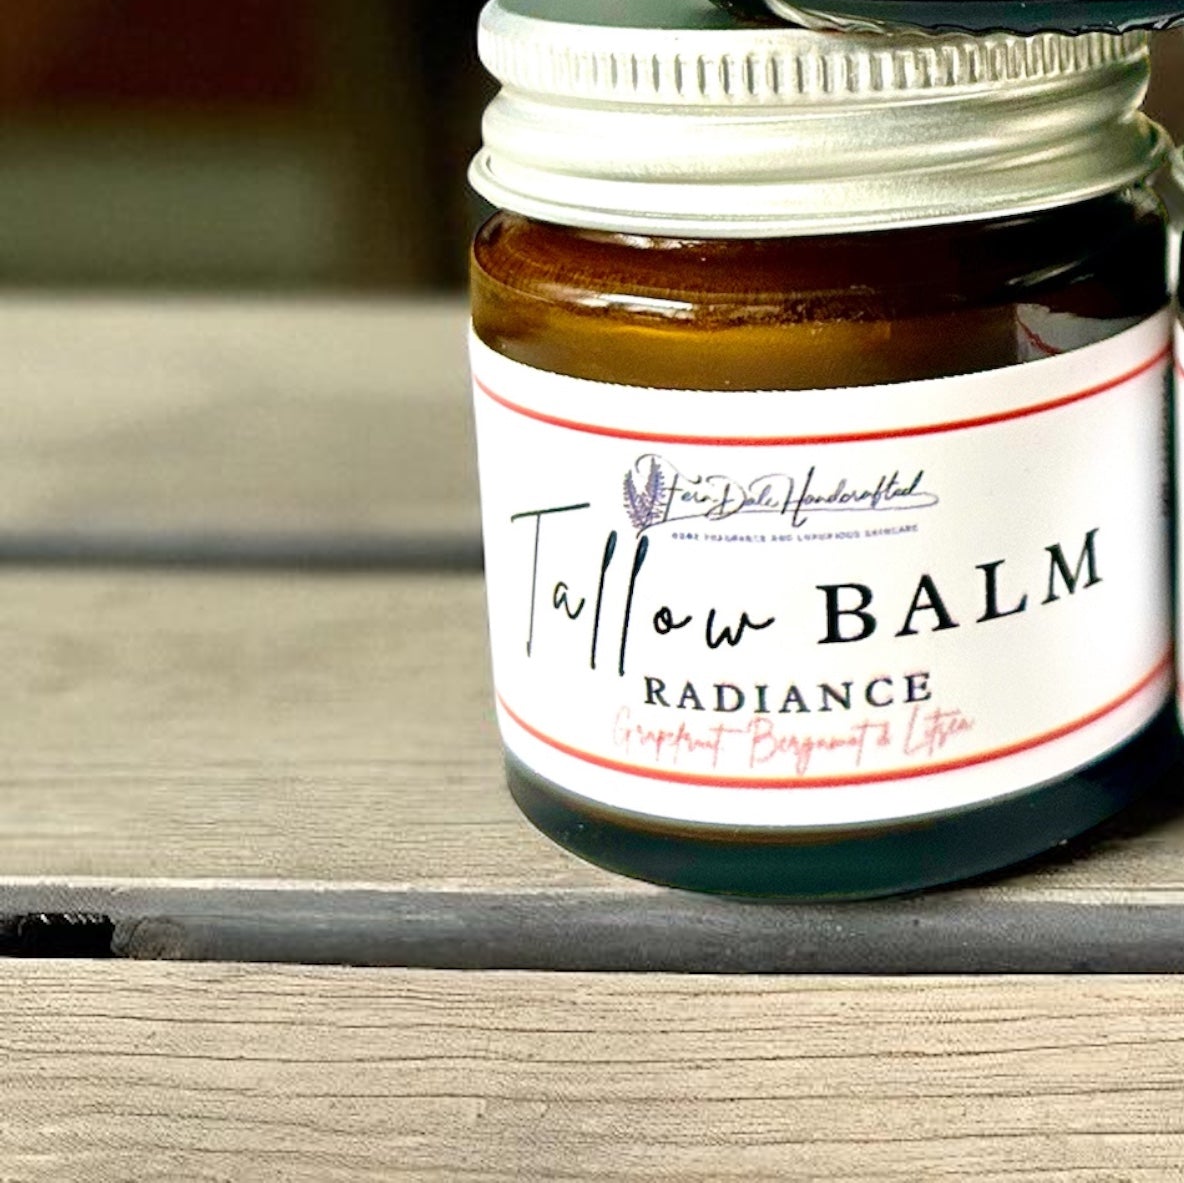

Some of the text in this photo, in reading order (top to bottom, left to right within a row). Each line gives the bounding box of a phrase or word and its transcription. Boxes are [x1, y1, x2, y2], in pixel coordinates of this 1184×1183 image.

[750, 466, 924, 528] Handcrafted
[511, 503, 1103, 676] Tallow BALM
[643, 671, 933, 714] RADIANCE
[748, 716, 880, 776] Bergamot
